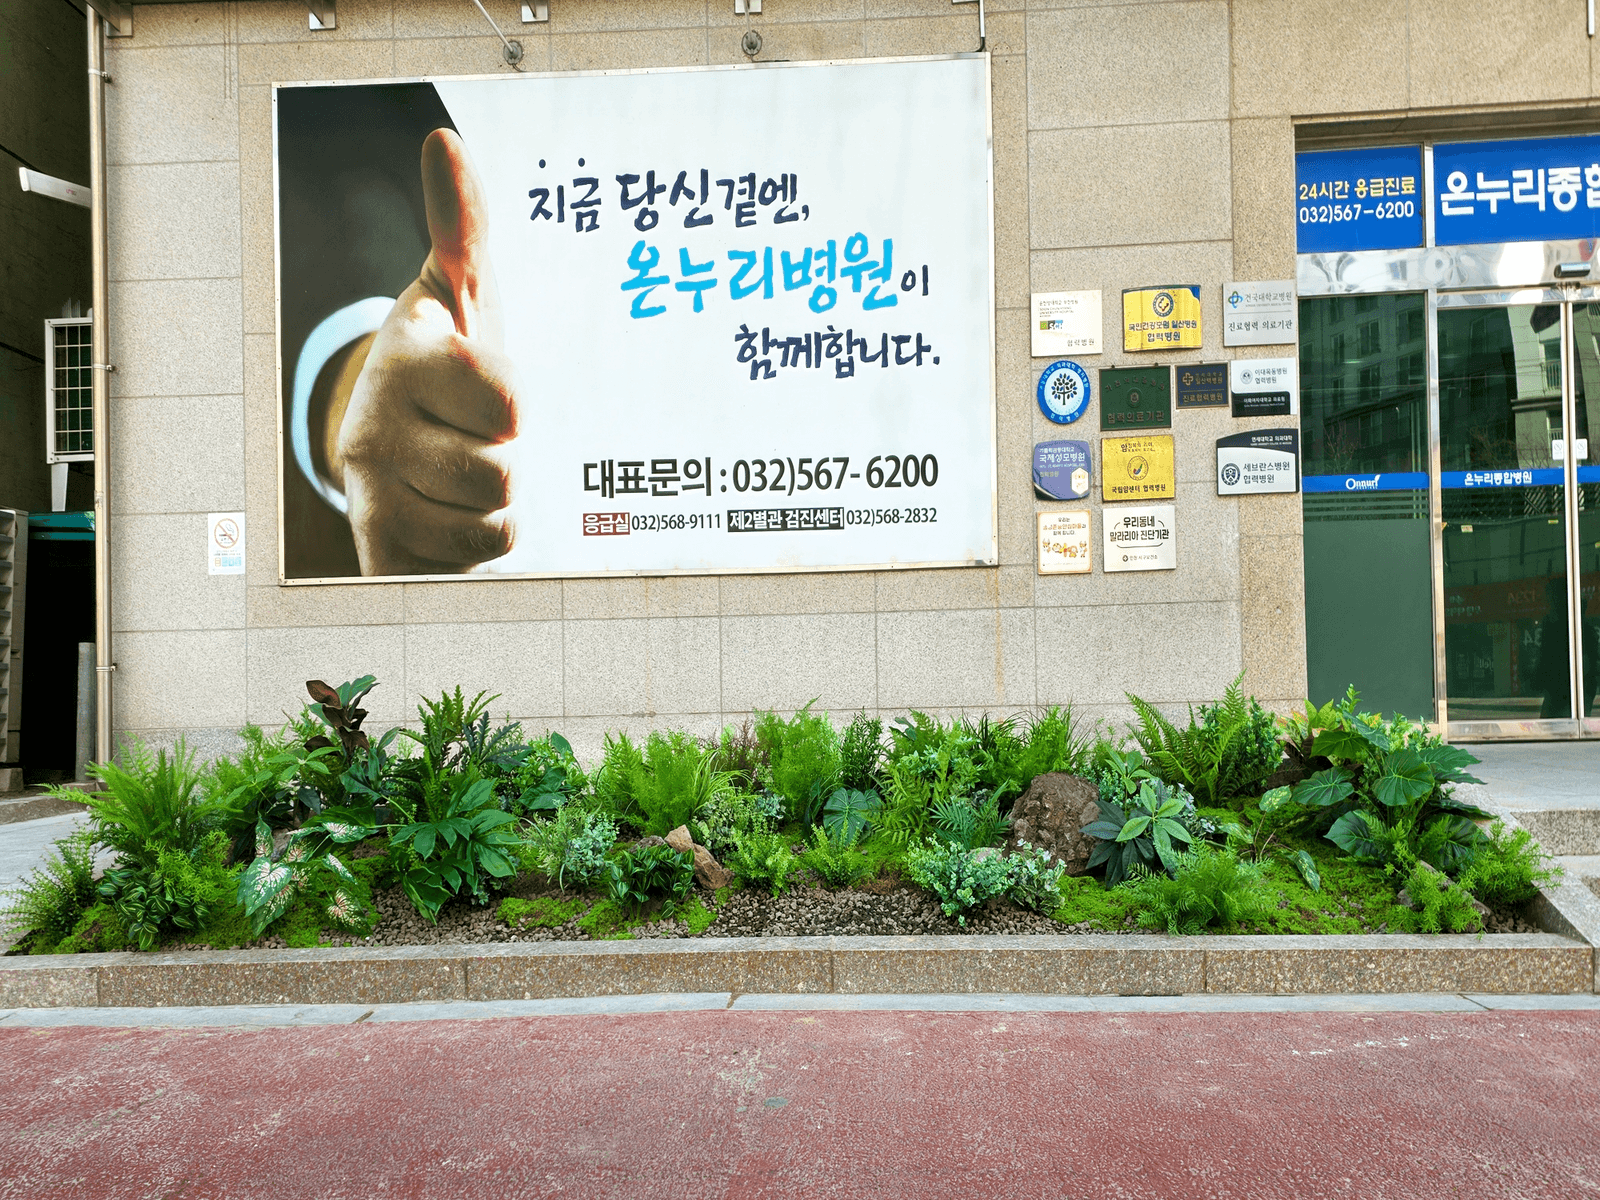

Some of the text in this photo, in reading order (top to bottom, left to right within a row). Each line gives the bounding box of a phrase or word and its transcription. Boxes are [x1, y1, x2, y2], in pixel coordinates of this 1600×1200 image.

[1299, 176, 1416, 200] 24시간 응급진료
[529, 158, 602, 232] 지금
[1299, 200, 1415, 224] 032)567-6200
[1245, 291, 1292, 302] 건국대학교병원
[1228, 319, 1293, 332] 진료협력 의료기관
[1107, 410, 1165, 424] 협력의료기관
[1039, 452, 1086, 464] 국제성모병원
[1243, 461, 1290, 472] 세브란스병원
[1243, 473, 1275, 484] 협력병원
[1345, 474, 1381, 490] Onnuri
[1464, 471, 1532, 486] 온누리종합병원
[1143, 483, 1166, 493] 협력병원
[583, 507, 938, 535] 응급실 032)568-9111 제2별관 검진센터 032)568-2832
[1123, 515, 1155, 528] 우리동네
[1110, 529, 1170, 542] 말라리아 진단기관
